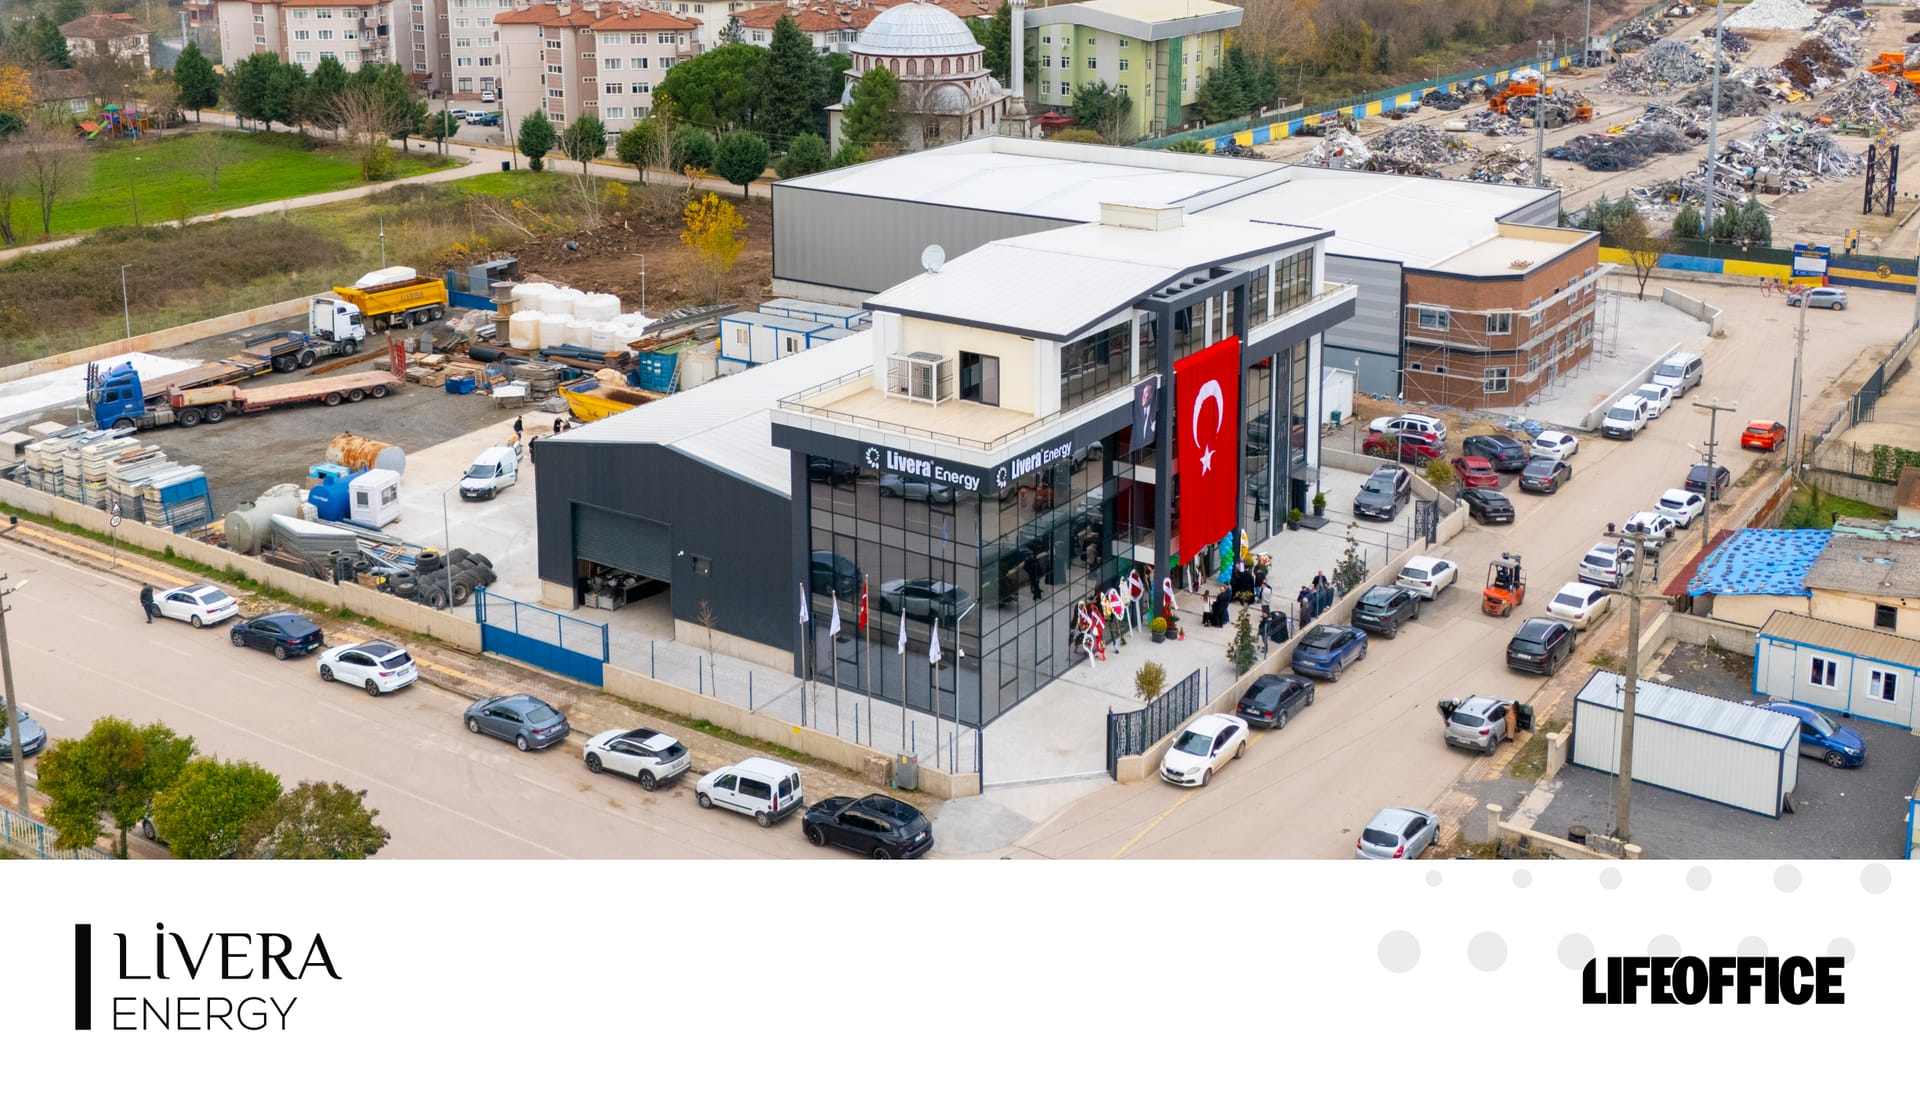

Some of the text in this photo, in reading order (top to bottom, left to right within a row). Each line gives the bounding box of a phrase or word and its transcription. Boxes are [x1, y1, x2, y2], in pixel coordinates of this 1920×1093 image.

[886, 450, 980, 491] Livera Energy
[1011, 441, 1072, 480] Livera Energy
